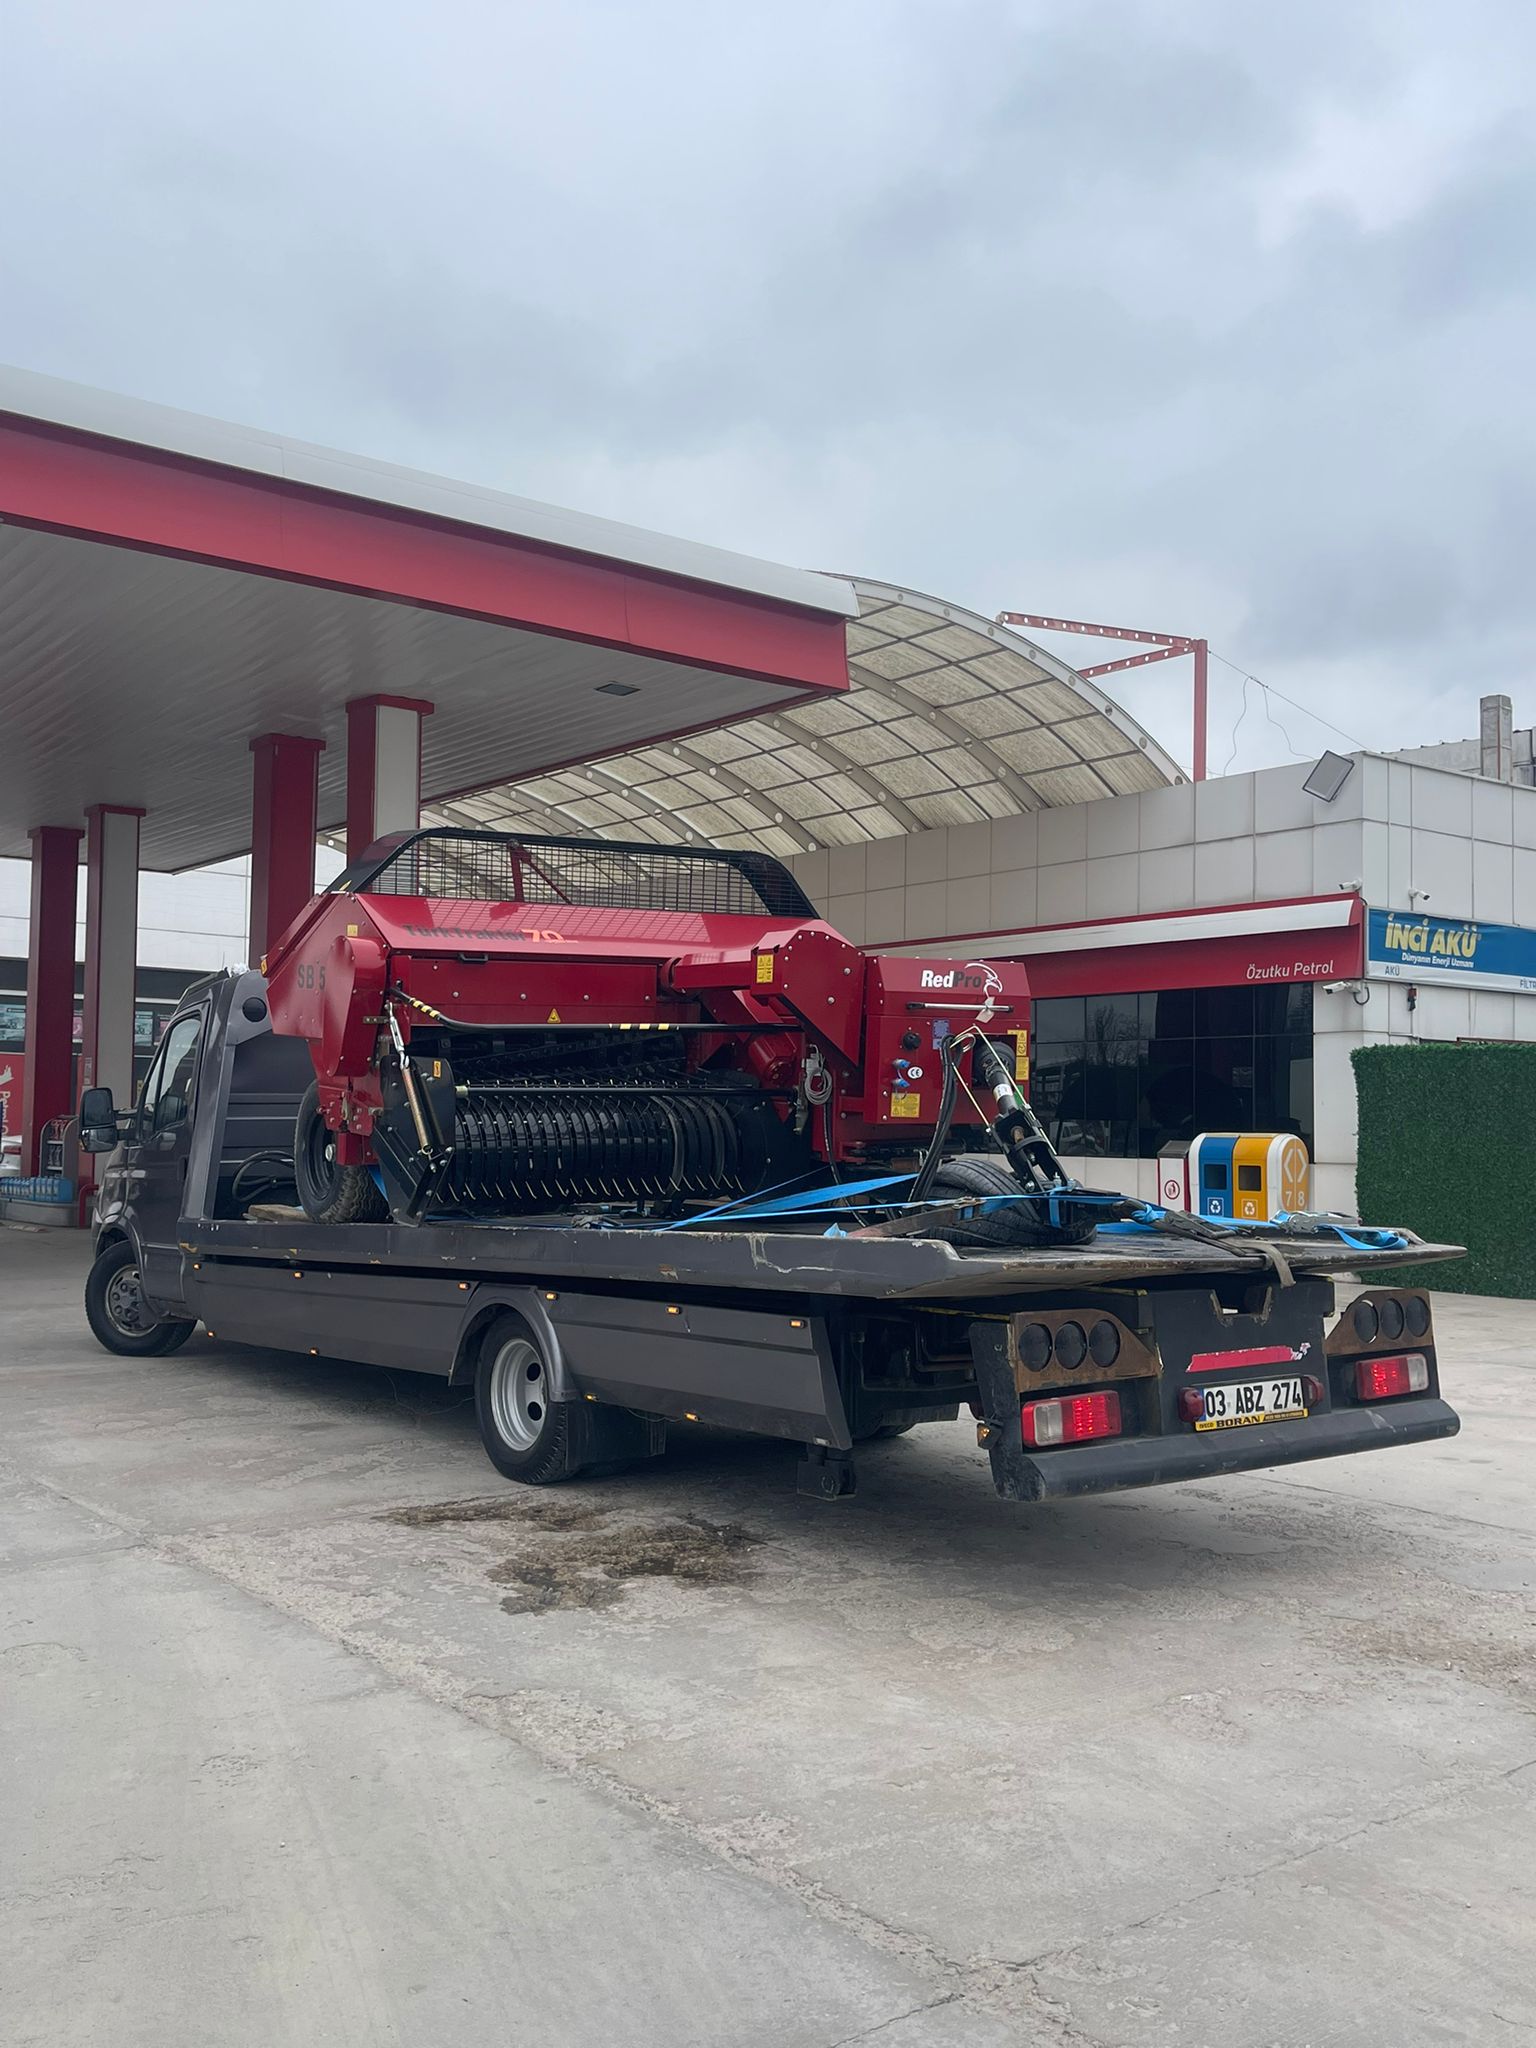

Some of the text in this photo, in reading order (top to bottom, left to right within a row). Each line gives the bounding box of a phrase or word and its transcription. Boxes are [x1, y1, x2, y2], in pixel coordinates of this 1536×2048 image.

[1385, 913, 1477, 958] İNCİ AKÜ
[1402, 952, 1474, 968] Dünyanın Enerji Uzmanı
[1246, 959, 1334, 979] Özutku Petrol
[1384, 964, 1400, 976] AKÜ
[921, 969, 982, 988] RedPro
[1285, 1191, 1293, 1206] 7
[1297, 1191, 1305, 1207] 8
[1205, 1381, 1302, 1418] 03 ABZ 274
[1216, 1415, 1261, 1428] BORAN
